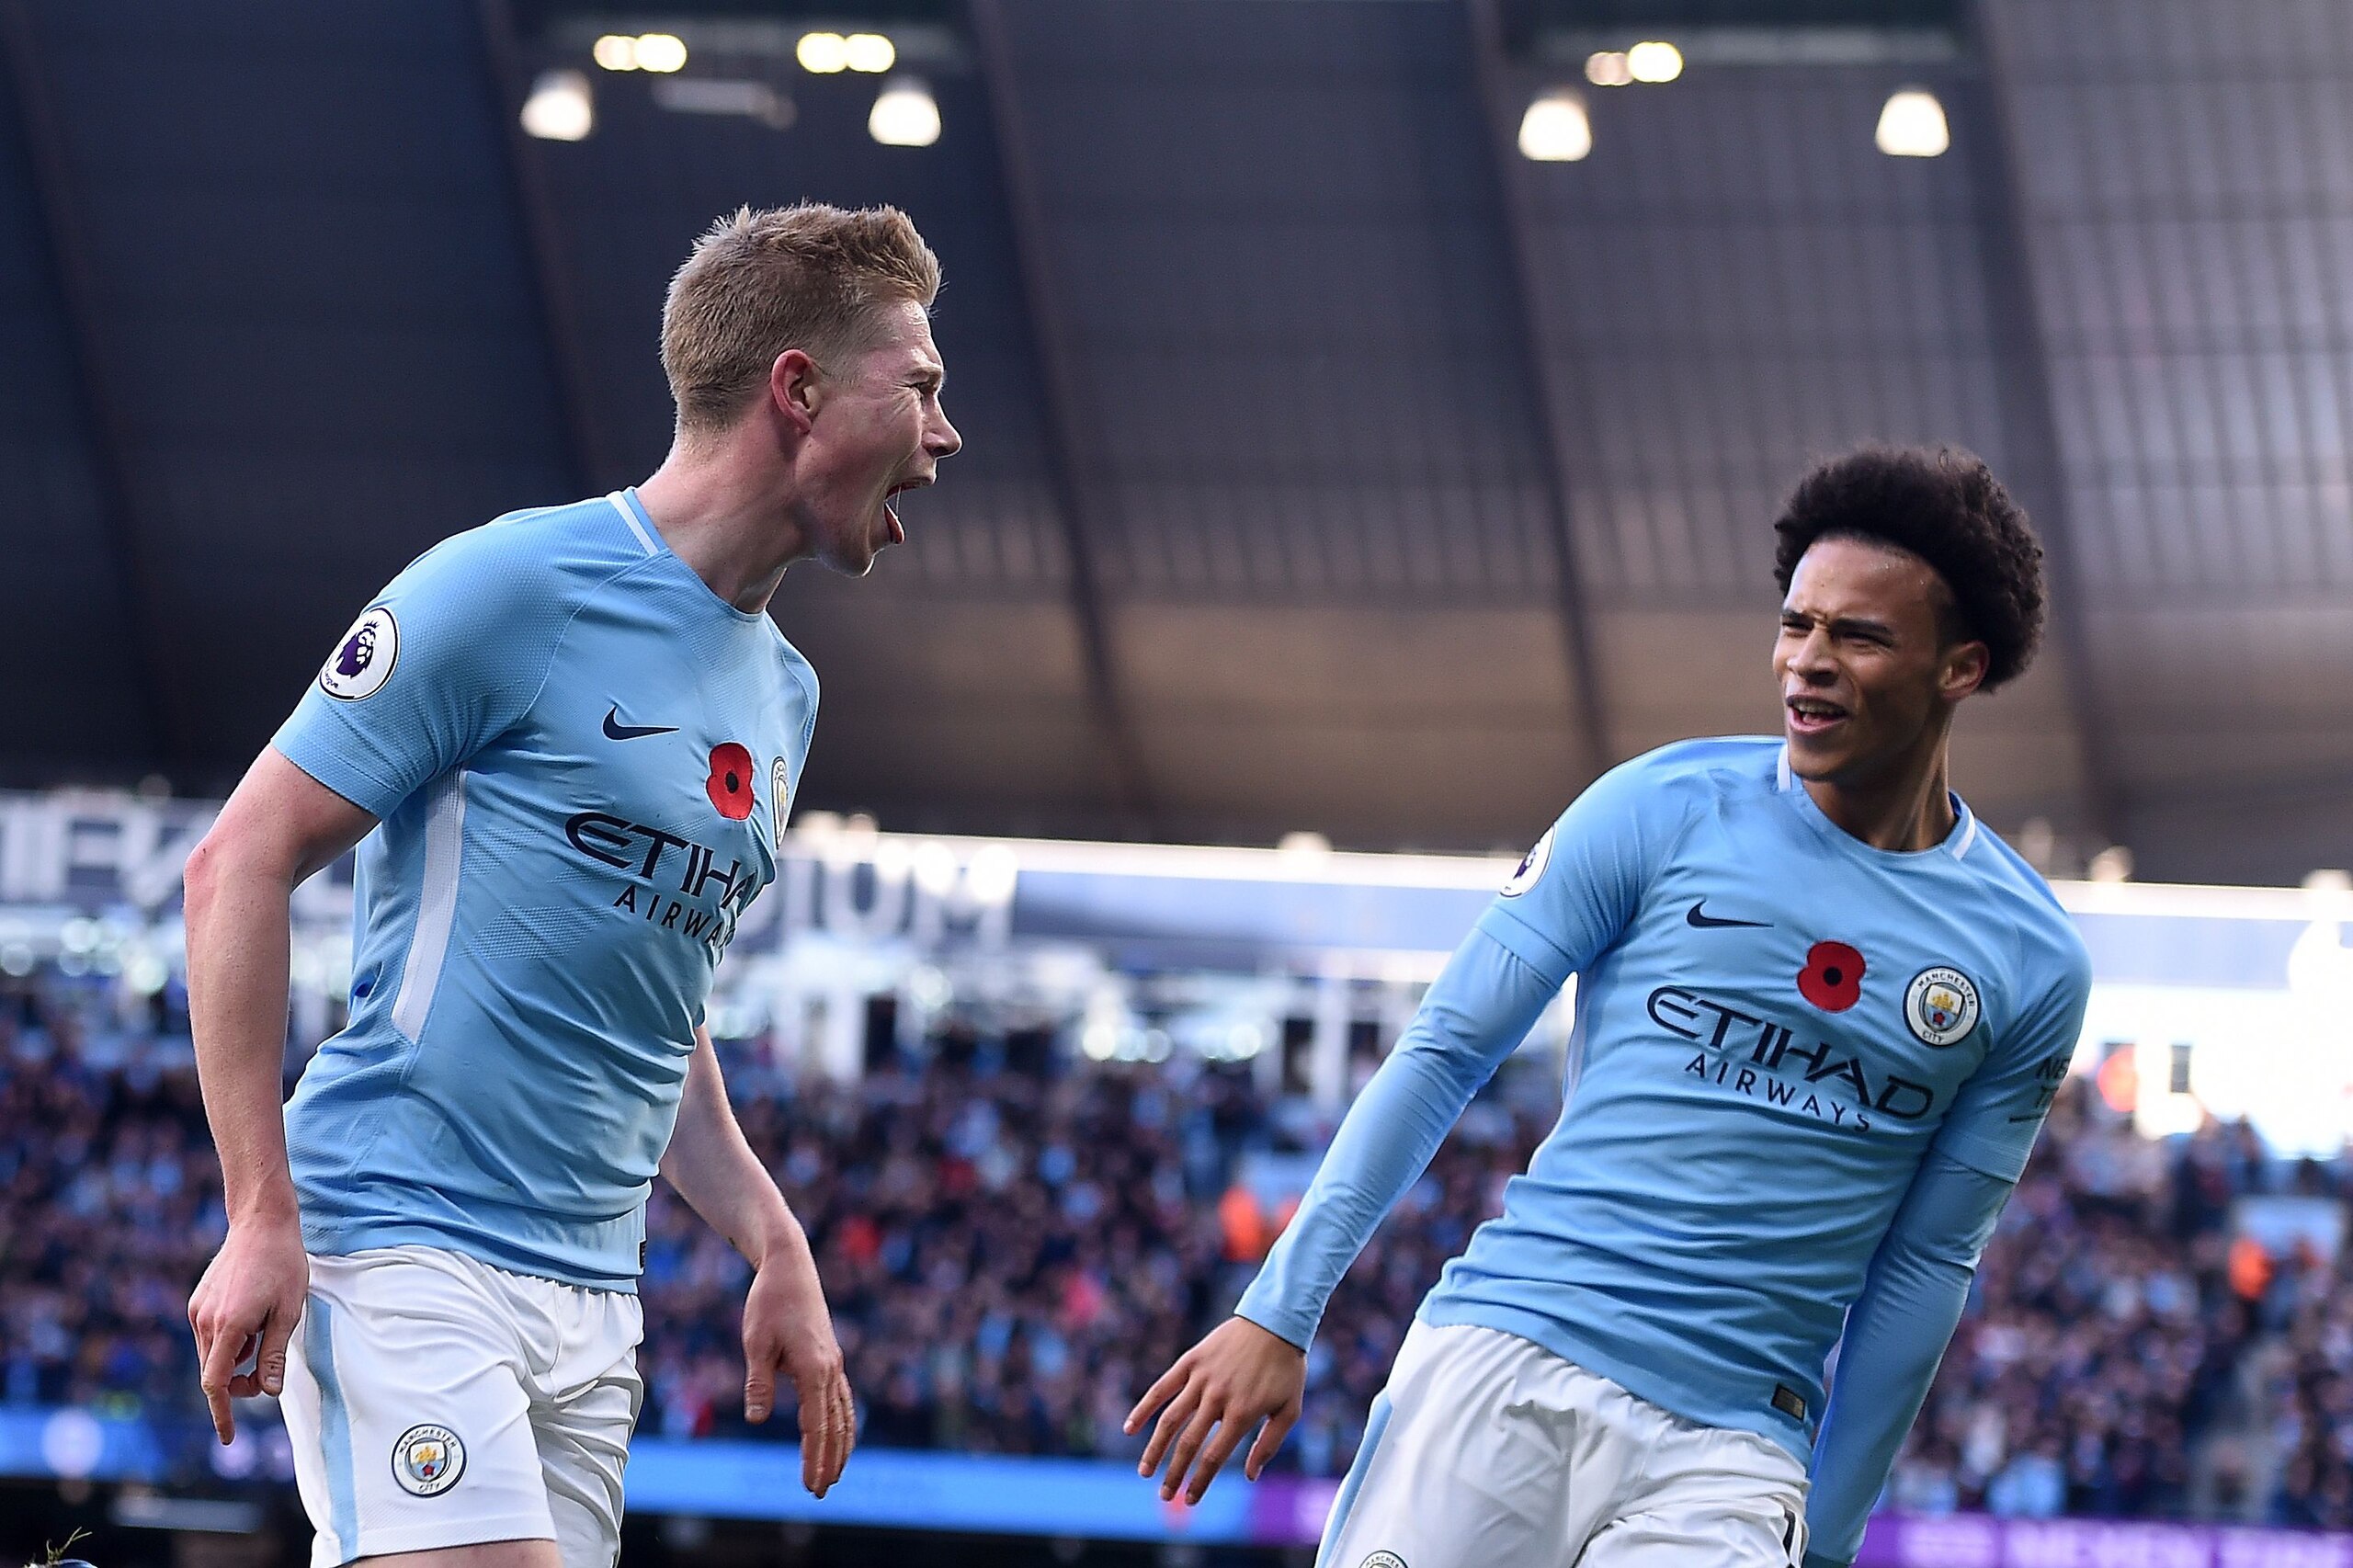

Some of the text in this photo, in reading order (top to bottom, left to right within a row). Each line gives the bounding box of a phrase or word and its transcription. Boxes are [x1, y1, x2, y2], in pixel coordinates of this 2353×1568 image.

[564, 812, 761, 918] ETIHA
[613, 884, 737, 949] AIRWA
[1917, 972, 1975, 1007] MANCHESTER
[1647, 986, 1934, 1119] ETIHAD
[1922, 1030, 1943, 1044] CITY
[1685, 1052, 1870, 1132] AIRWAYS
[399, 1427, 457, 1453] MANCHESTER
[418, 1482, 441, 1494] CITY
